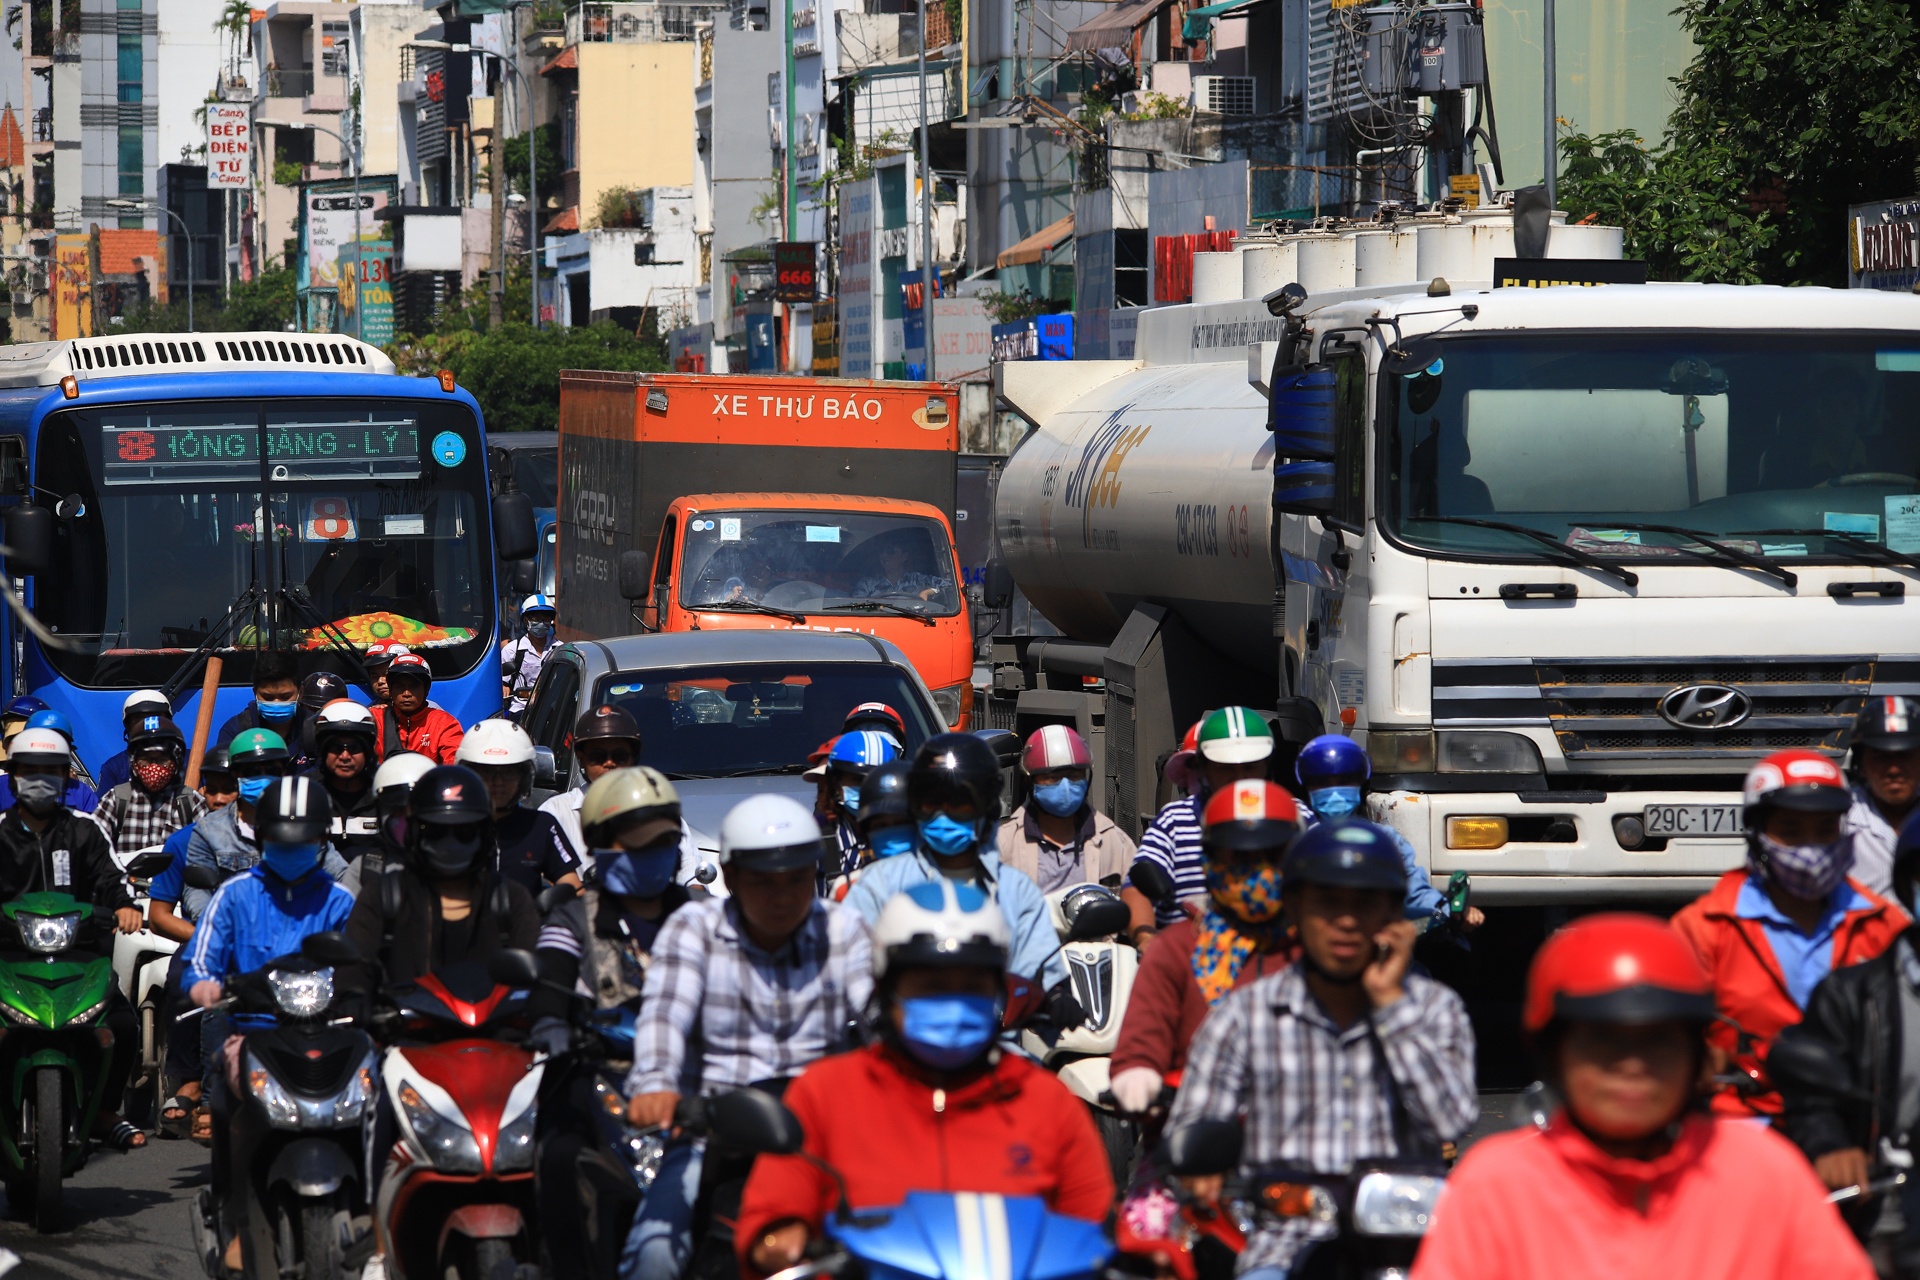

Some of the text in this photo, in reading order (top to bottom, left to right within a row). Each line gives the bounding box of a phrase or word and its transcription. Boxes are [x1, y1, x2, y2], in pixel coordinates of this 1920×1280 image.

[780, 271, 811, 284] 666
[712, 393, 882, 420] XE THƯ BÁO
[118, 431, 156, 461] 8
[364, 425, 399, 454] LÝ
[313, 497, 349, 538] 8
[573, 490, 615, 545] KERRY
